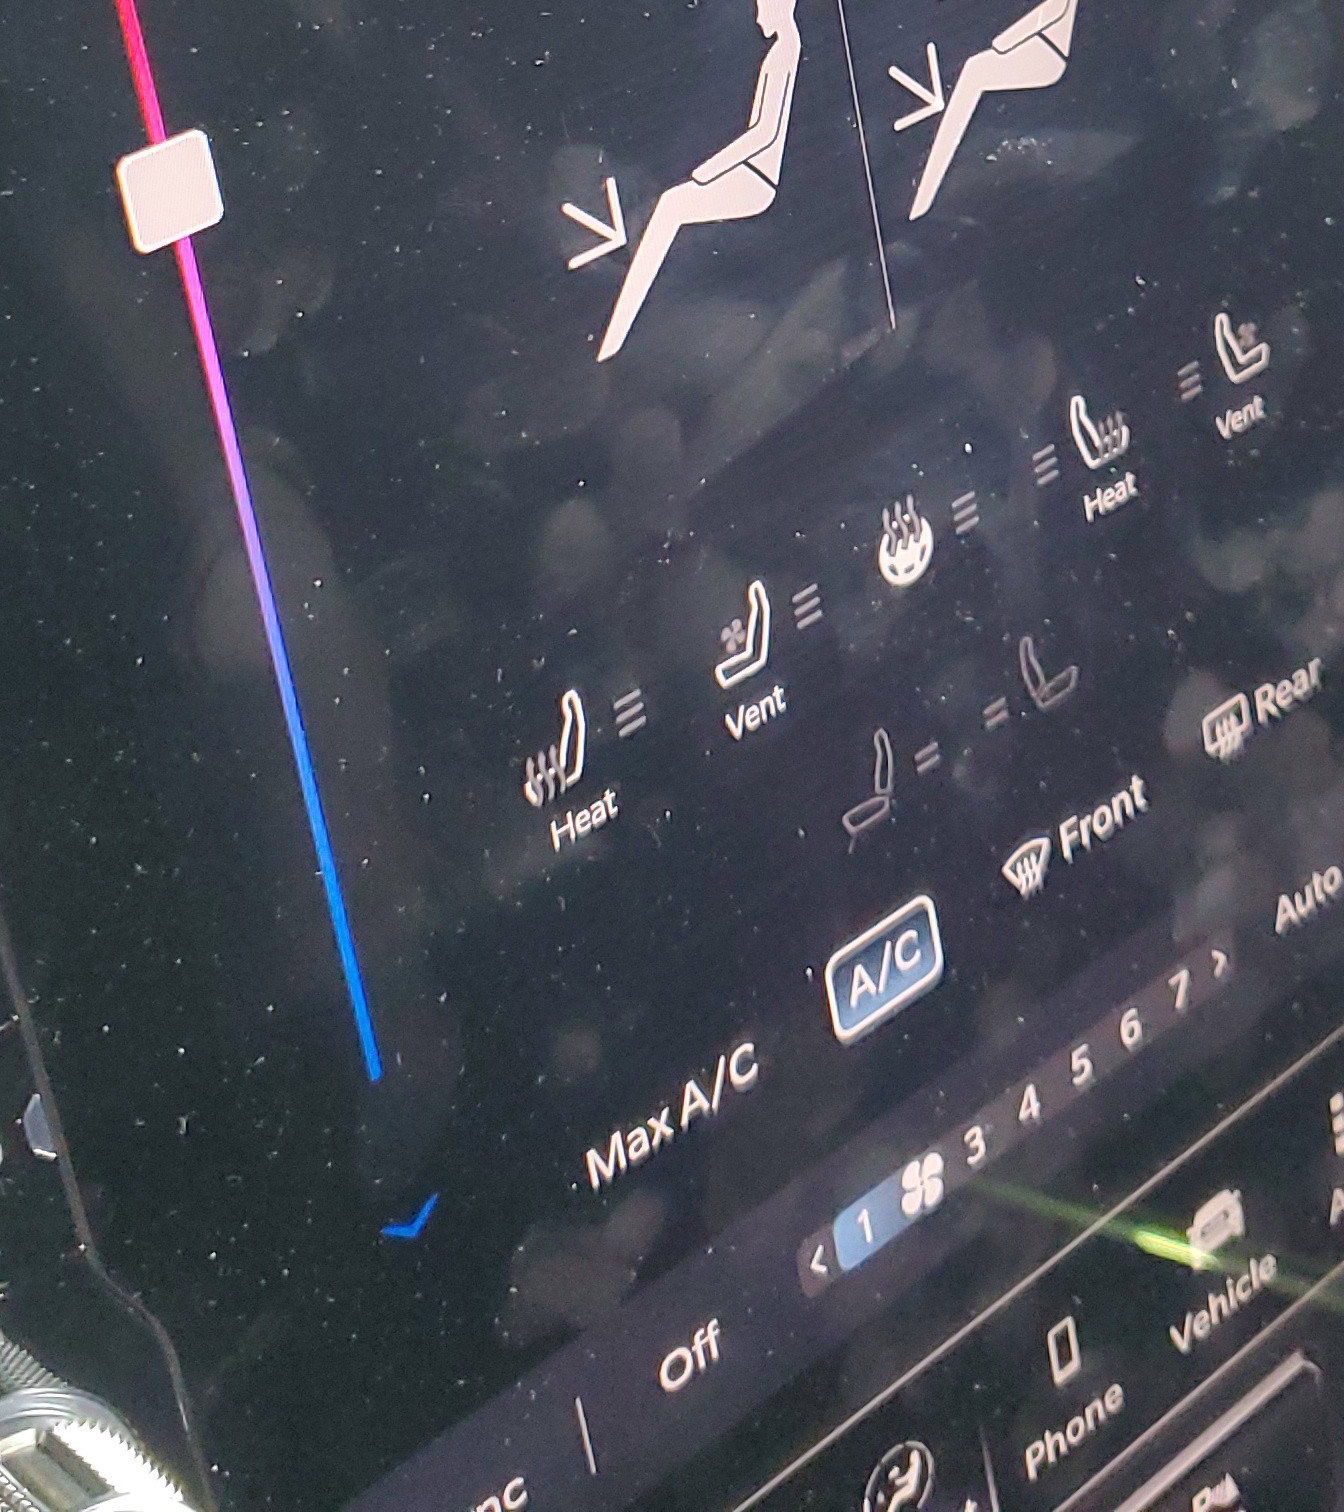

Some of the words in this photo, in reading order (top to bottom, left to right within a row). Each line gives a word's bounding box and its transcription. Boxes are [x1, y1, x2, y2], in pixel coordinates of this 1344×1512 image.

[1215, 393, 1265, 441] Vent
[1083, 471, 1139, 523] Heat
[723, 684, 787, 741] Vent
[1254, 656, 1325, 724] Rear
[548, 788, 620, 851] Heat
[1058, 773, 1151, 862] Front
[1274, 863, 1344, 935] Auto
[849, 927, 922, 1008] A/C
[585, 1107, 674, 1192] Max
[680, 1042, 759, 1132] A/C
[857, 1207, 874, 1244] 1
[963, 1124, 987, 1166] 3
[1018, 1083, 1042, 1123] 4
[1070, 1043, 1094, 1088] 5
[1119, 1006, 1143, 1050] 6
[1167, 968, 1191, 1012] 7
[1169, 1253, 1278, 1356] Vehicle
[659, 1318, 720, 1393] Off
[1025, 1383, 1125, 1482] Phone
